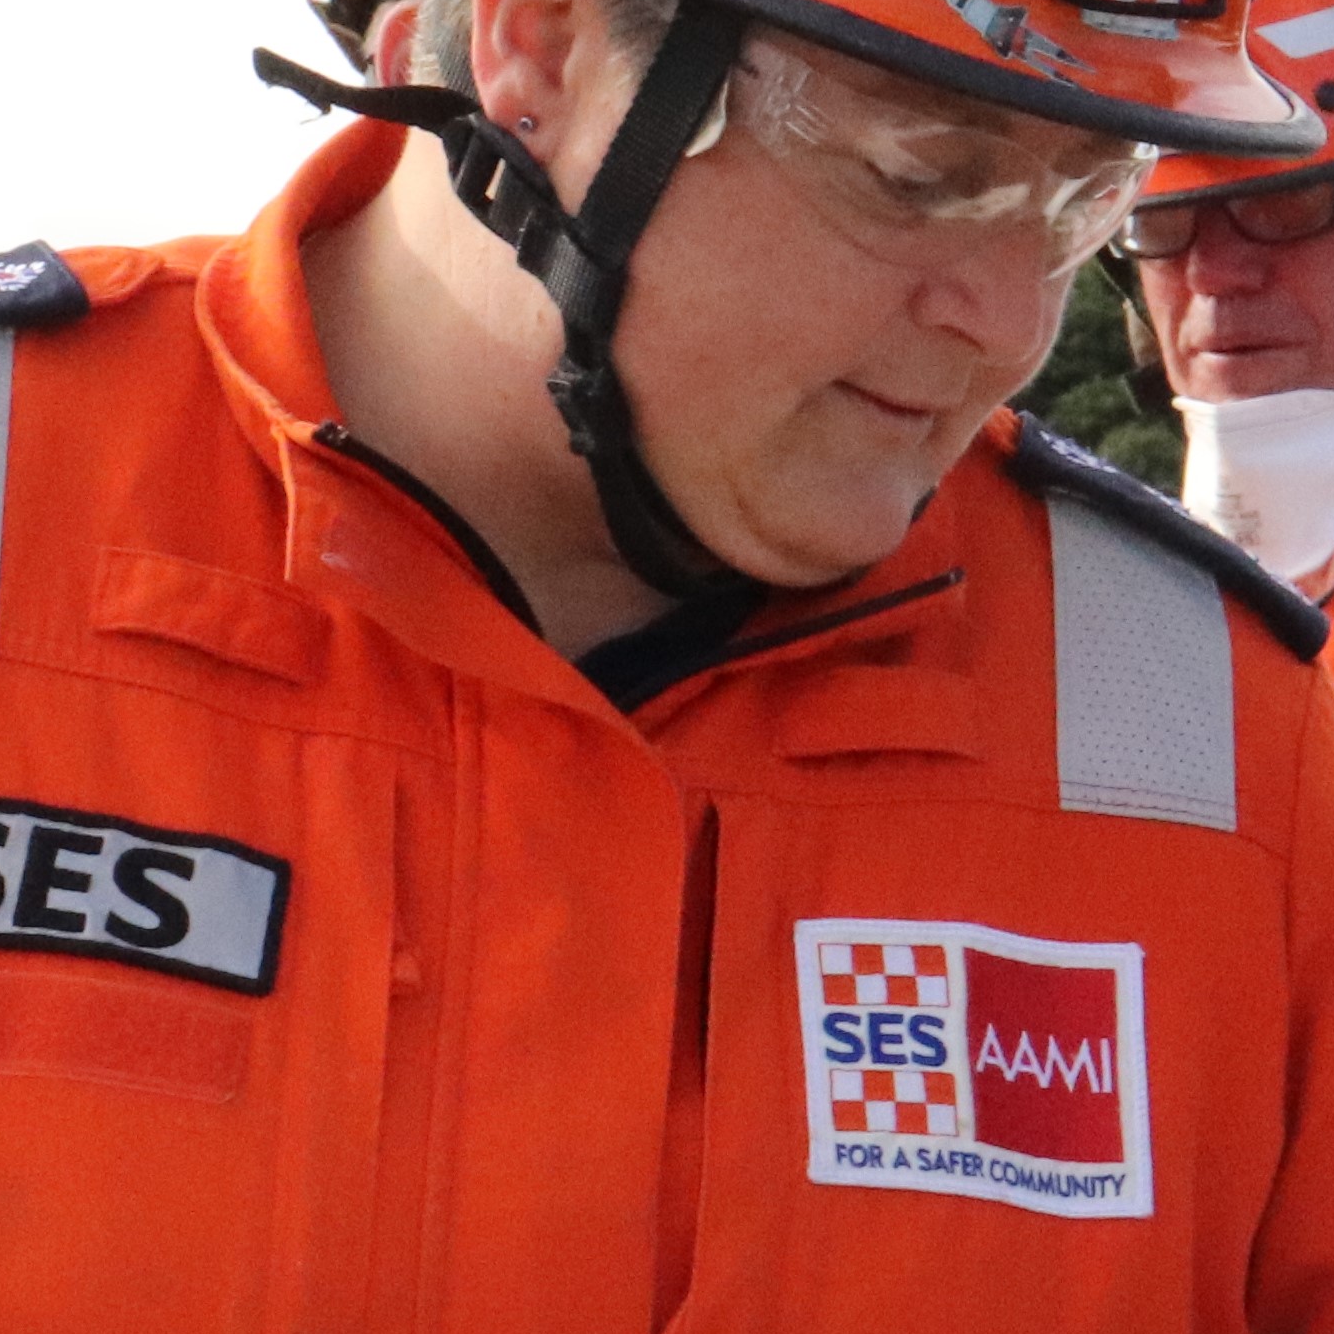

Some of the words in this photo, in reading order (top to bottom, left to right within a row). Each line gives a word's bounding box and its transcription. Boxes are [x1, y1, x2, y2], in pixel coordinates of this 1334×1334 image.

[822, 1012, 948, 1067] SES
[976, 1023, 1114, 1095] AAMI
[835, 1143, 884, 1169] FOR
[893, 1146, 912, 1169] A
[918, 1148, 986, 1178] SAFER
[989, 1159, 1127, 1199] COMMUNITY
